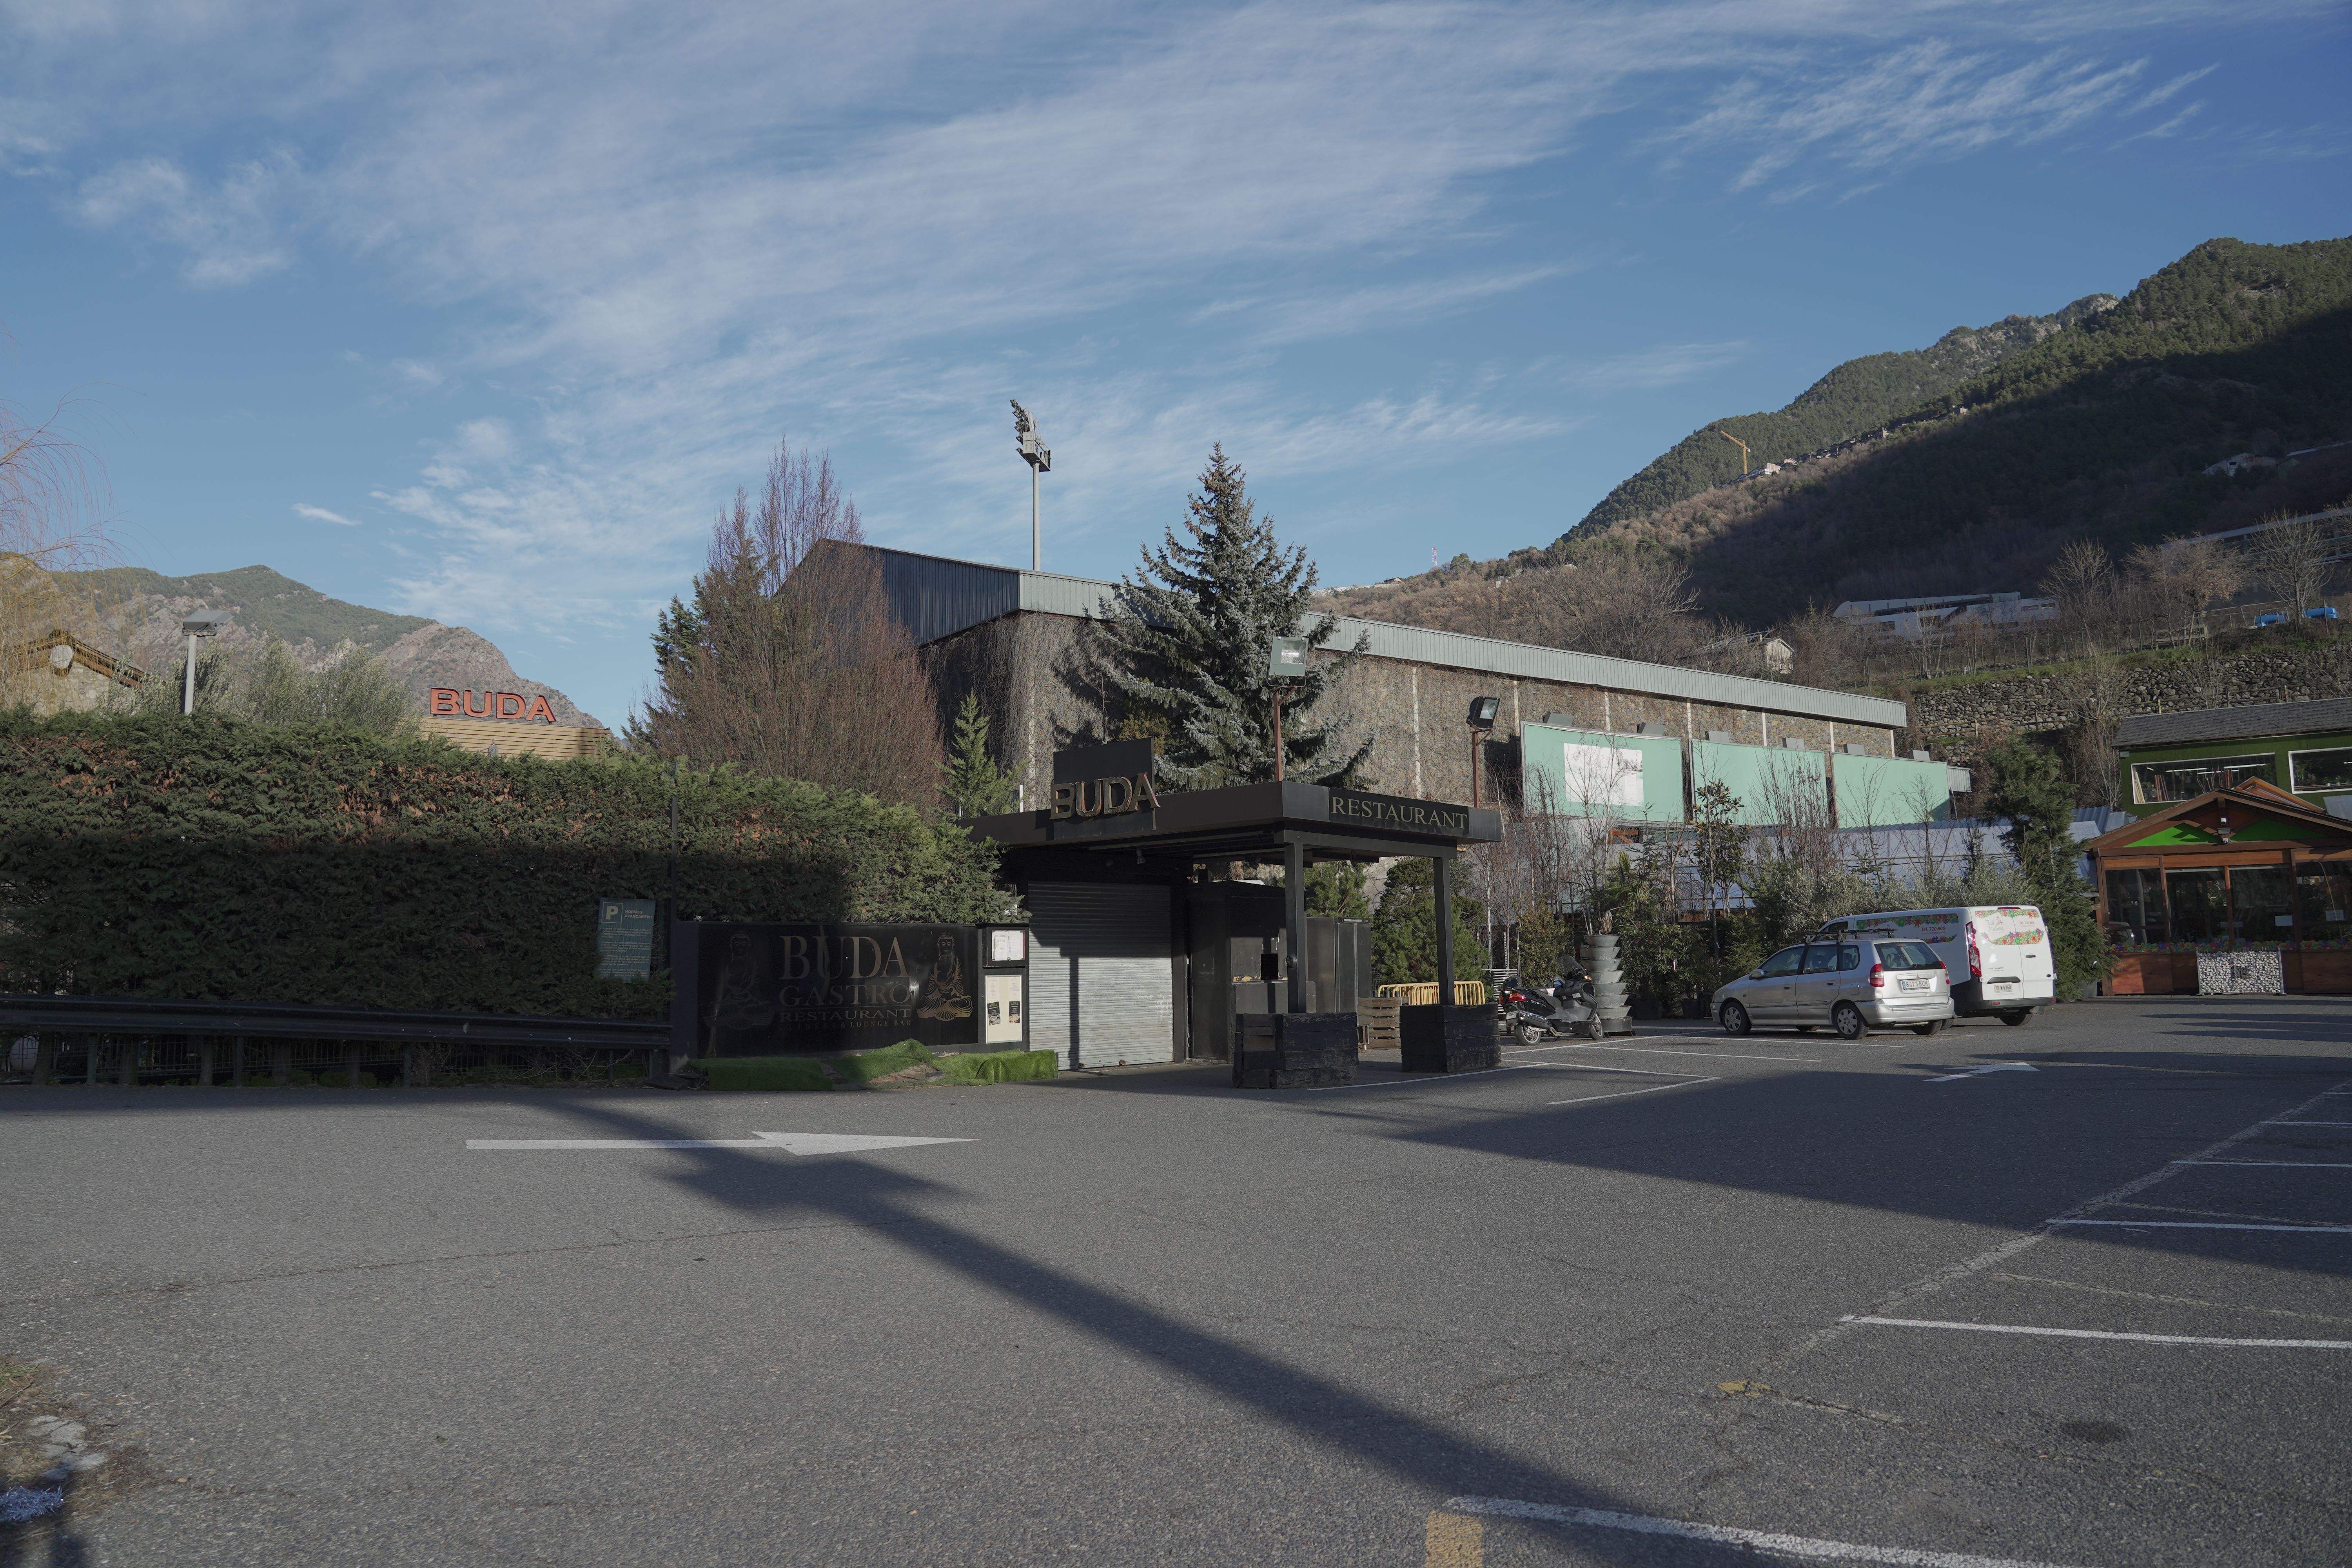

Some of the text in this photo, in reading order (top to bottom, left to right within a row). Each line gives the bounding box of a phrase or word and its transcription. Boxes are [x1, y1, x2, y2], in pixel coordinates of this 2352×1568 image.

[430, 687, 556, 722] BUDA
[1049, 773, 1161, 819] BUDA
[1330, 796, 1468, 829] RESTAURANT
[606, 906, 618, 920] P
[779, 936, 911, 979] BUDA
[779, 984, 911, 1006] GASTRO
[780, 1009, 911, 1022] RESTAURANT
